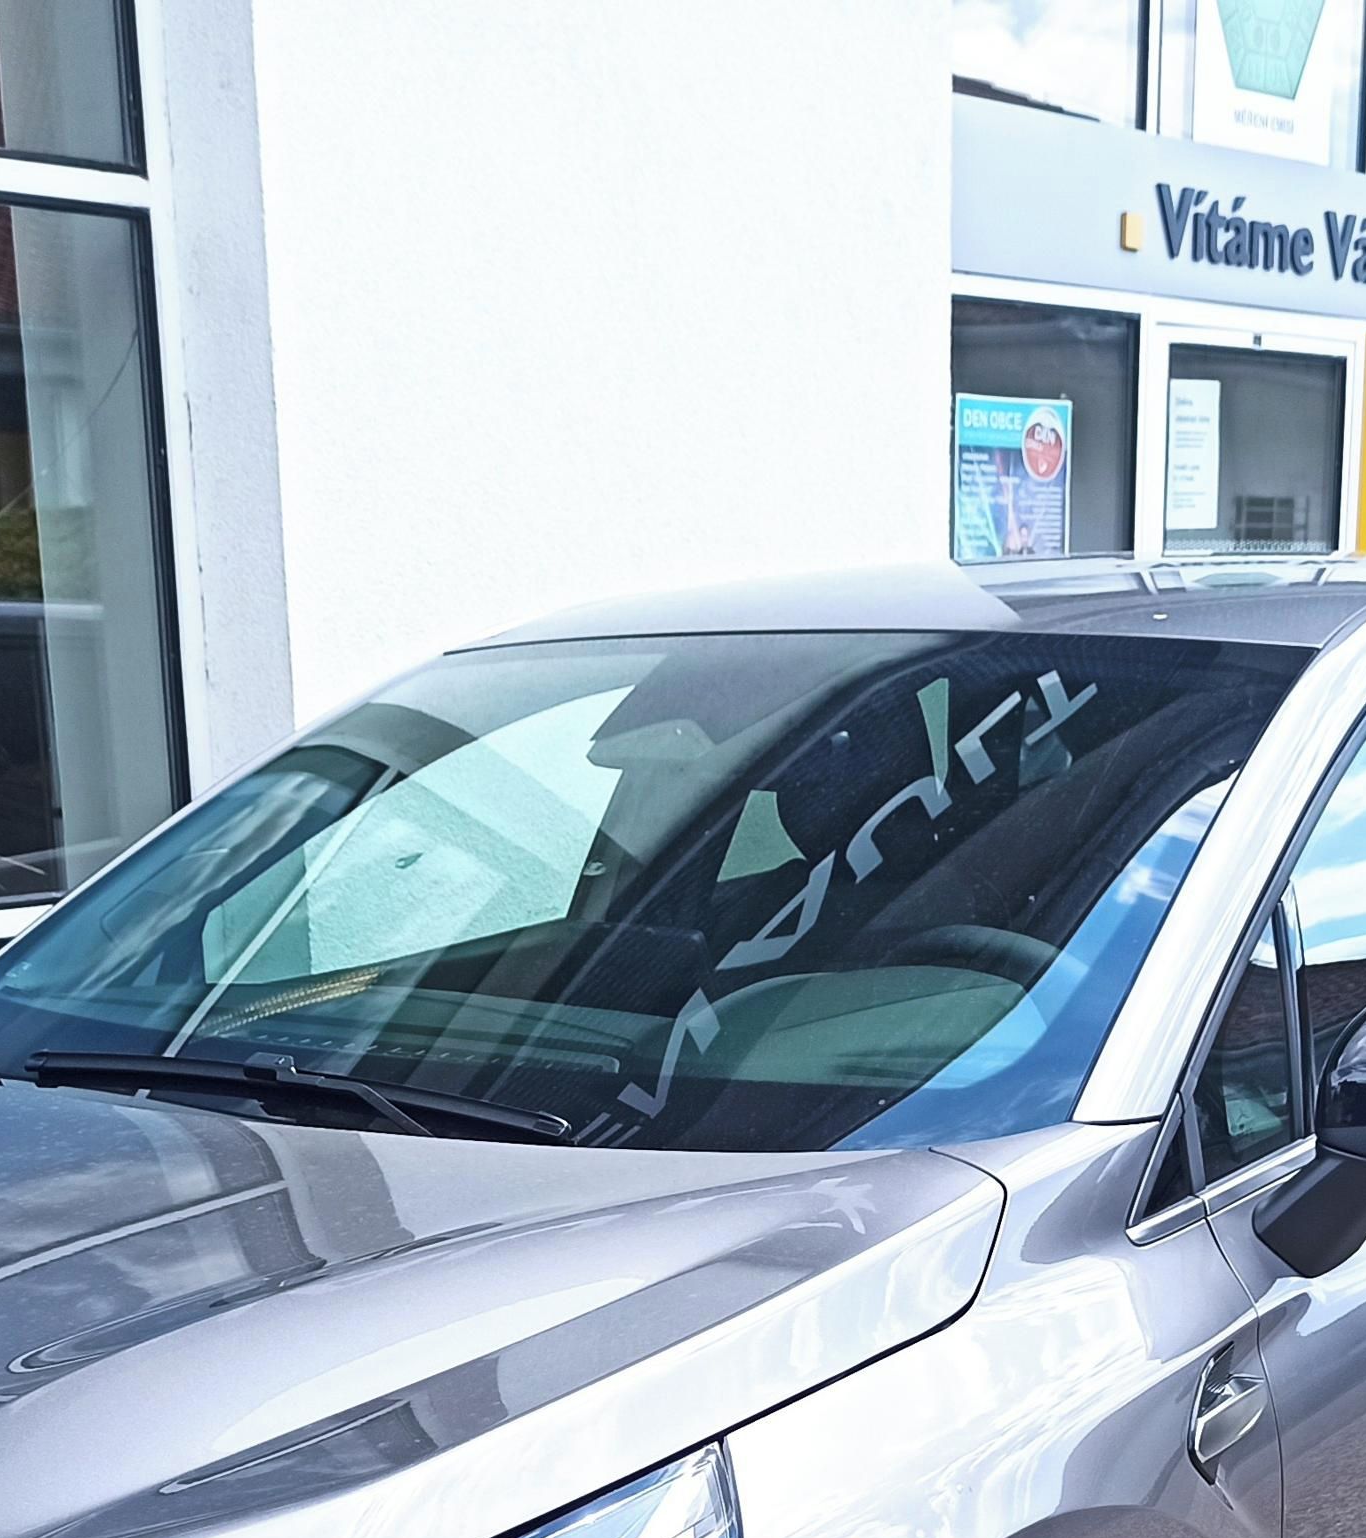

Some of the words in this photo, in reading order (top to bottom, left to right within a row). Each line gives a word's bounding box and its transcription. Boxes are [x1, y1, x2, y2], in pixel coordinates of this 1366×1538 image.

[1154, 182, 1315, 277] Vítáme
[963, 408, 988, 428] DEN
[989, 410, 1023, 431] OBCE
